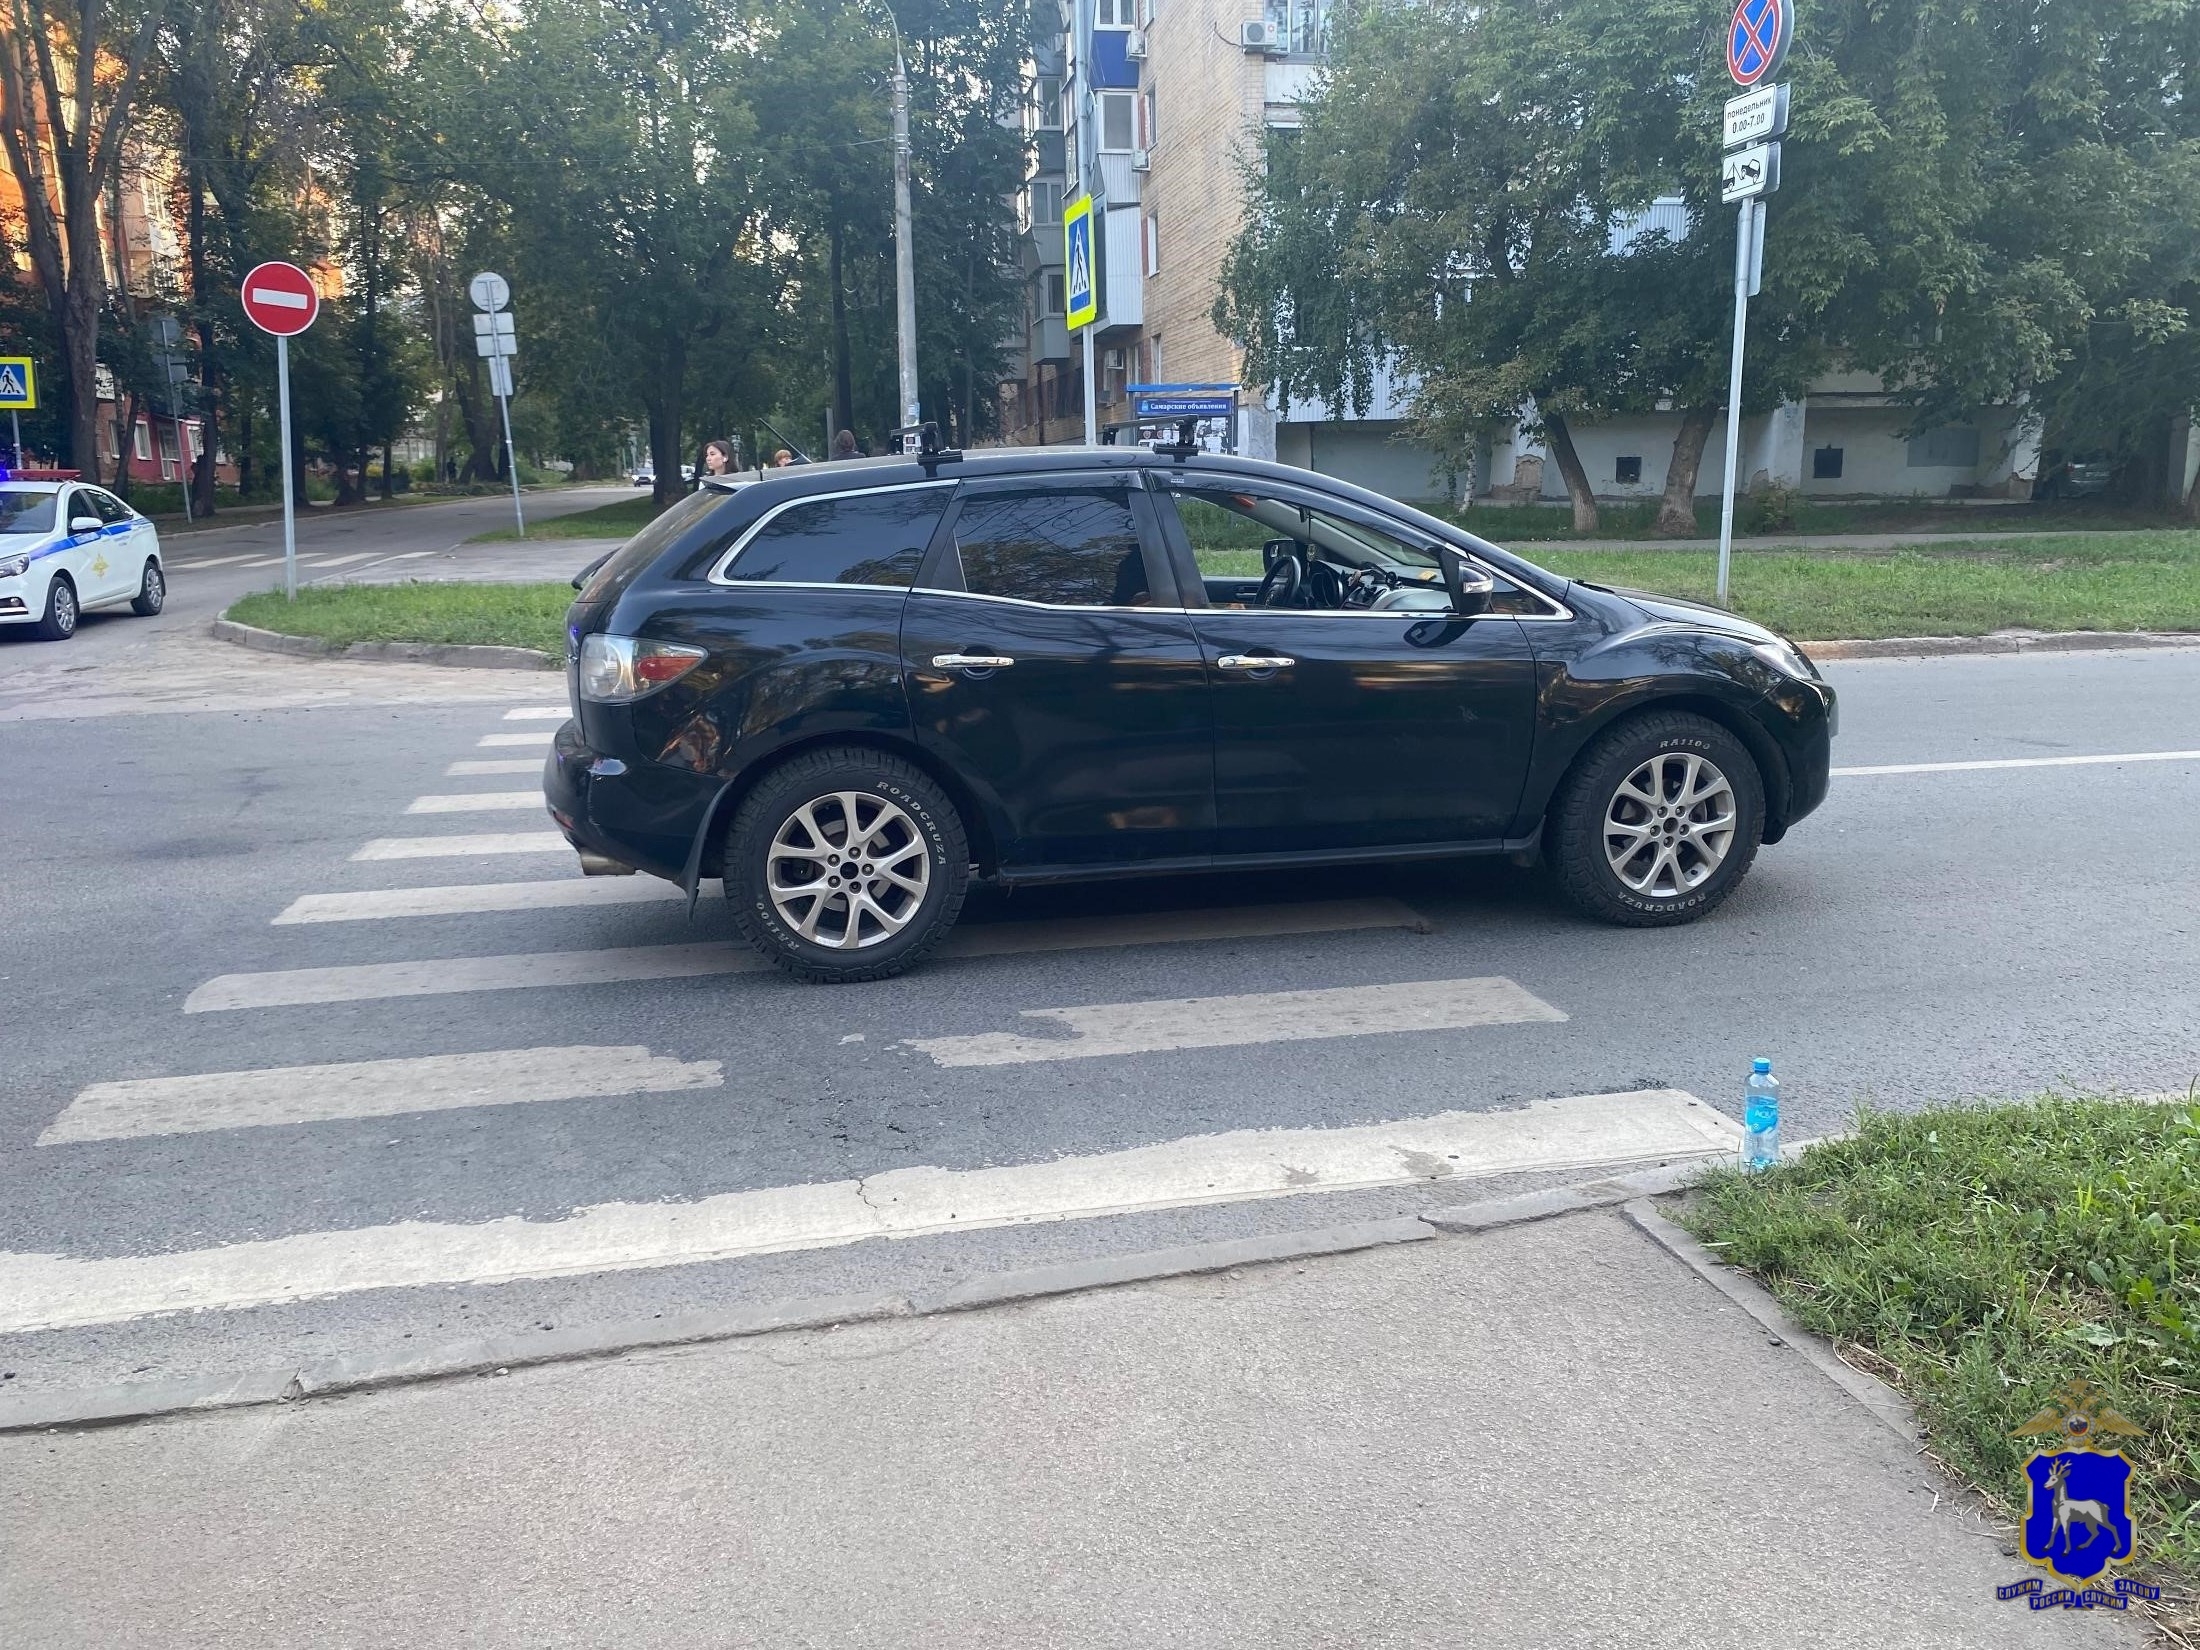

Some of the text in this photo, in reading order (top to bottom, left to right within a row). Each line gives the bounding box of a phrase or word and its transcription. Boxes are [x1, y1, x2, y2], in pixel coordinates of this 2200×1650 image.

[1727, 97, 1772, 119] понедельник
[1732, 114, 1765, 135] 0.00-7.00
[1150, 403, 1187, 411] Самарские
[875, 781, 947, 865] ROADCRUZA
